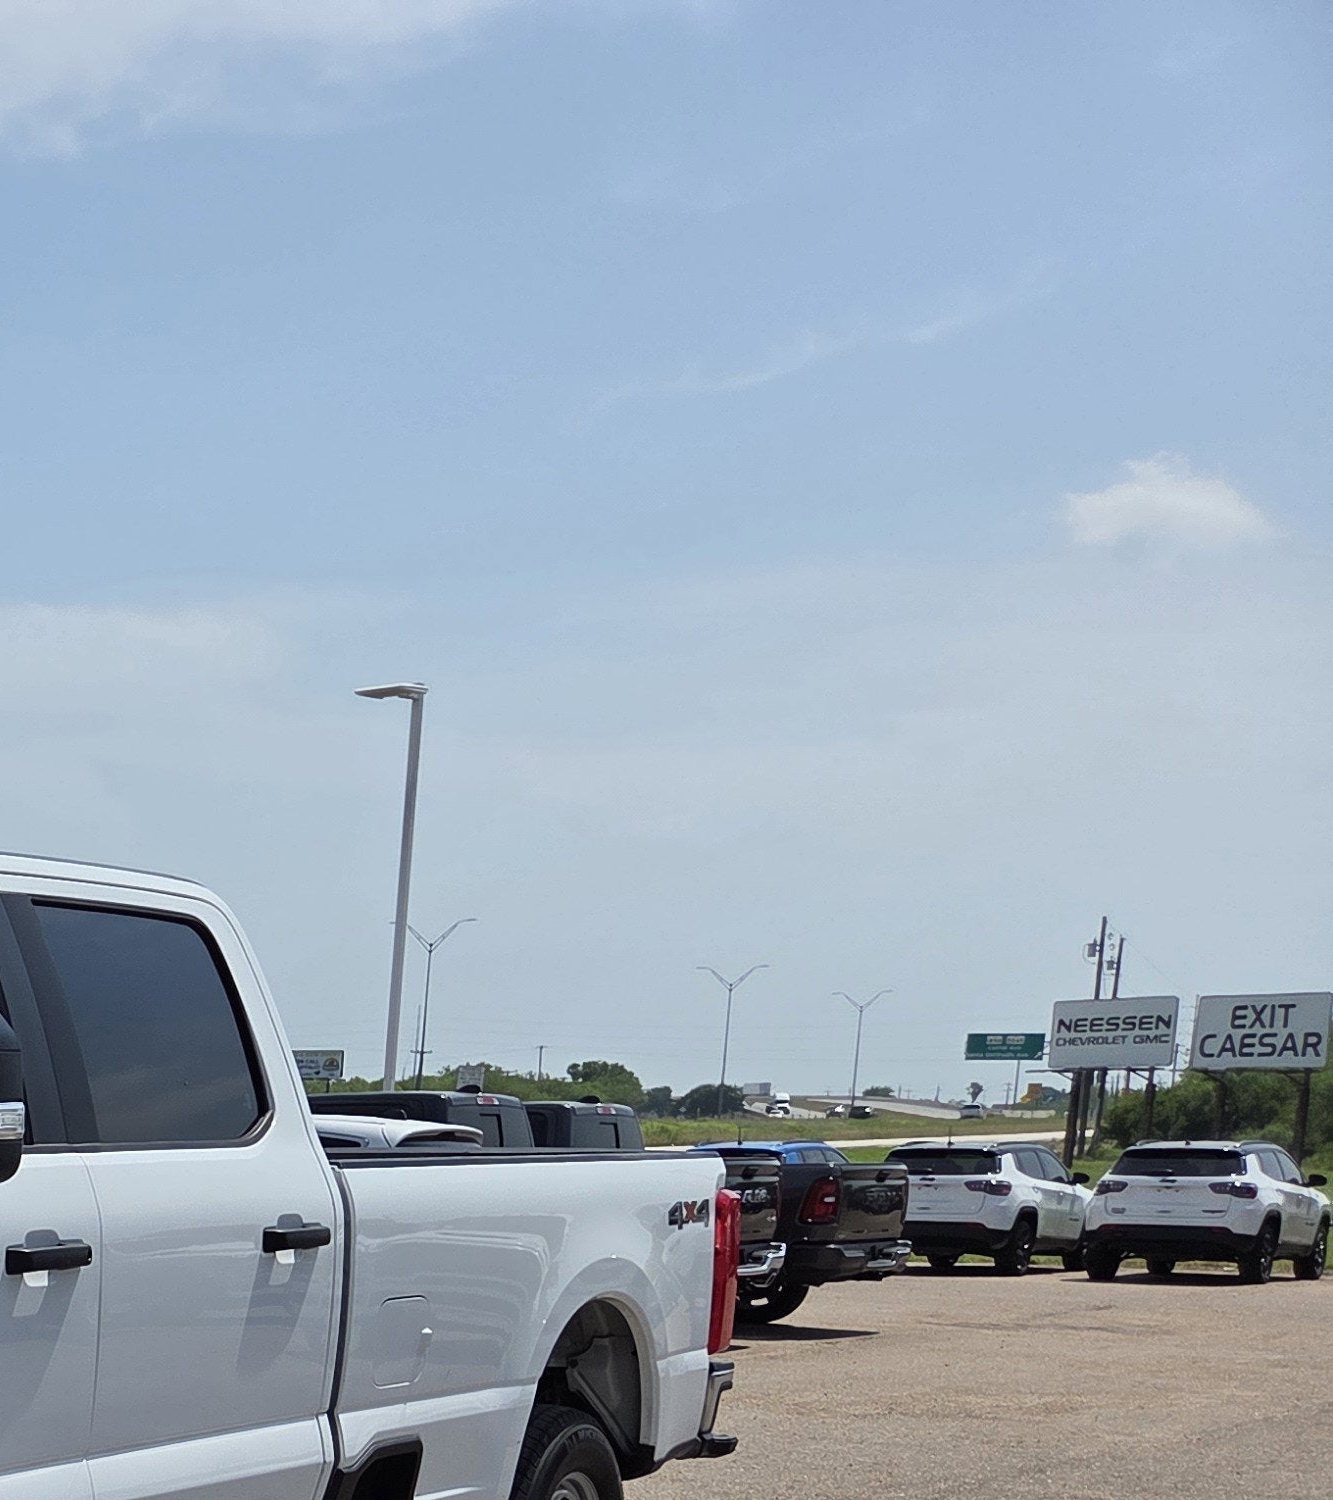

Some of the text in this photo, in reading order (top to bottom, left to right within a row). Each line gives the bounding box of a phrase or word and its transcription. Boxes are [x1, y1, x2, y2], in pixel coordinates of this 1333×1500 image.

[1056, 1013, 1173, 1034] NEESSEN
[1229, 1003, 1297, 1030] EXIT
[1054, 1032, 1171, 1047] CHEVROLET GMC
[1199, 1030, 1323, 1059] CAESAR
